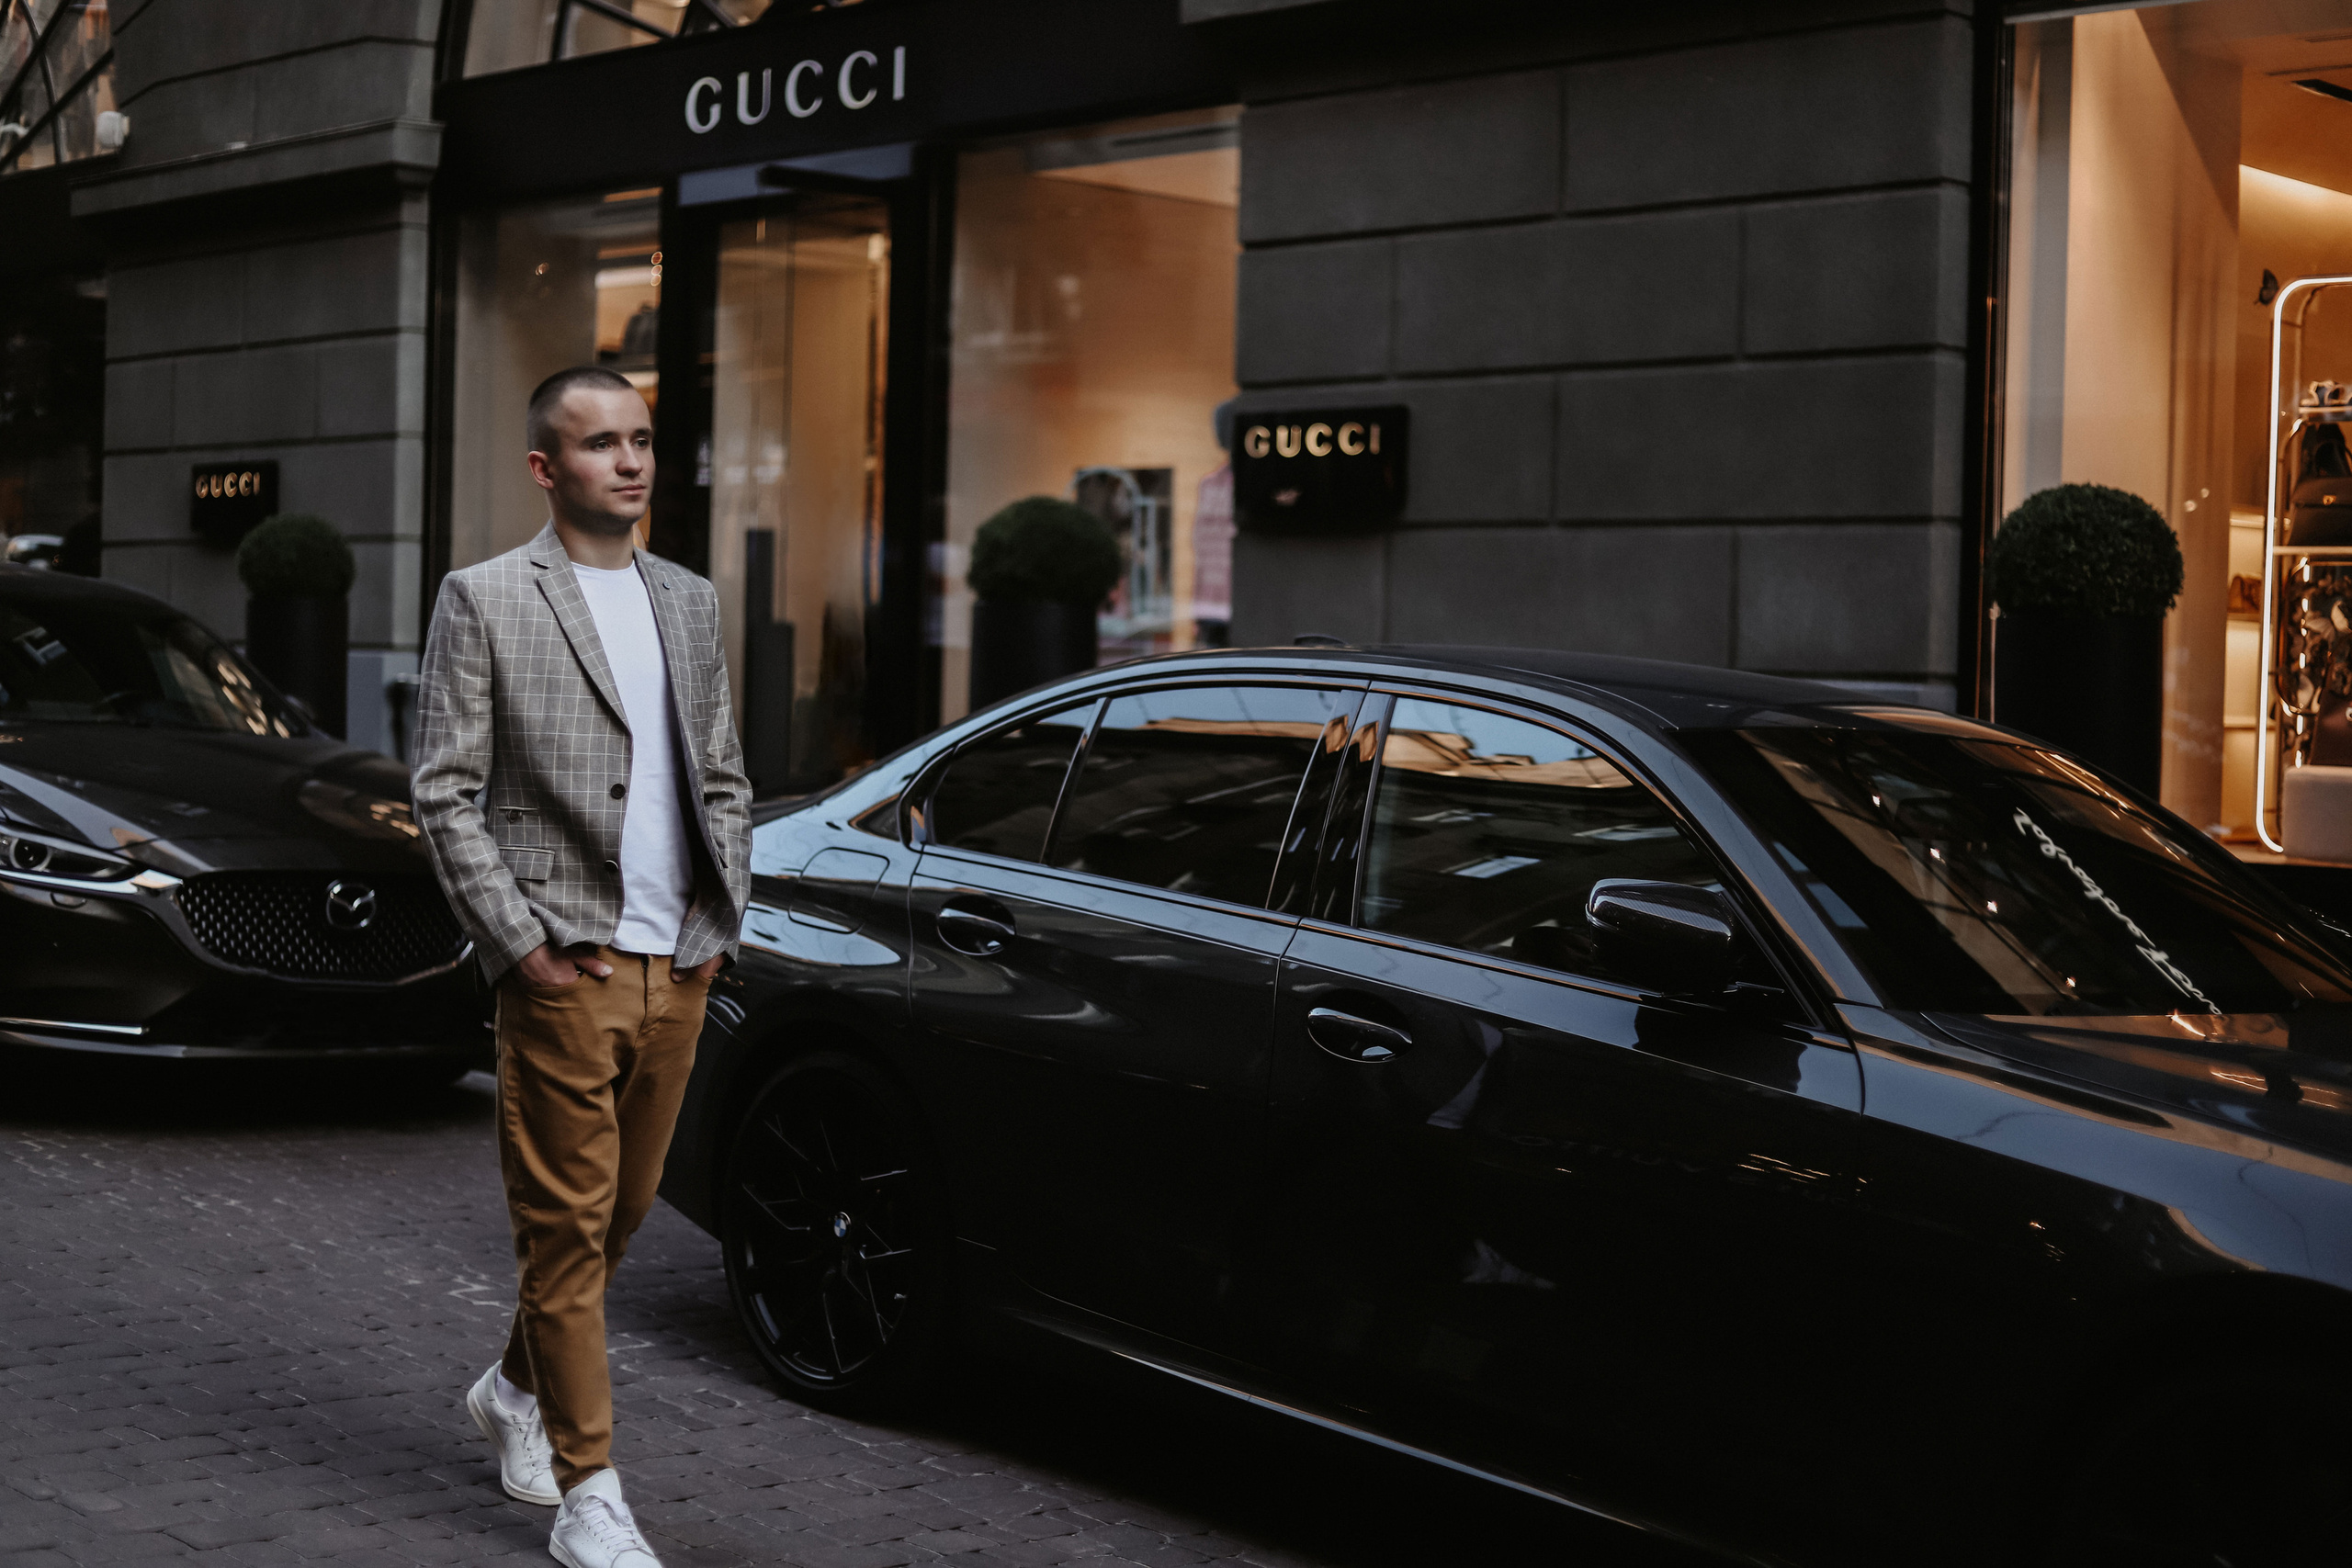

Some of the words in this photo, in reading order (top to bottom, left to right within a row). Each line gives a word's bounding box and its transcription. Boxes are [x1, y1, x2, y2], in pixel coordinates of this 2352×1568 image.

[684, 45, 906, 134] GUCCI
[1244, 421, 1381, 459] GUCCI
[195, 471, 261, 499] GUCCI
